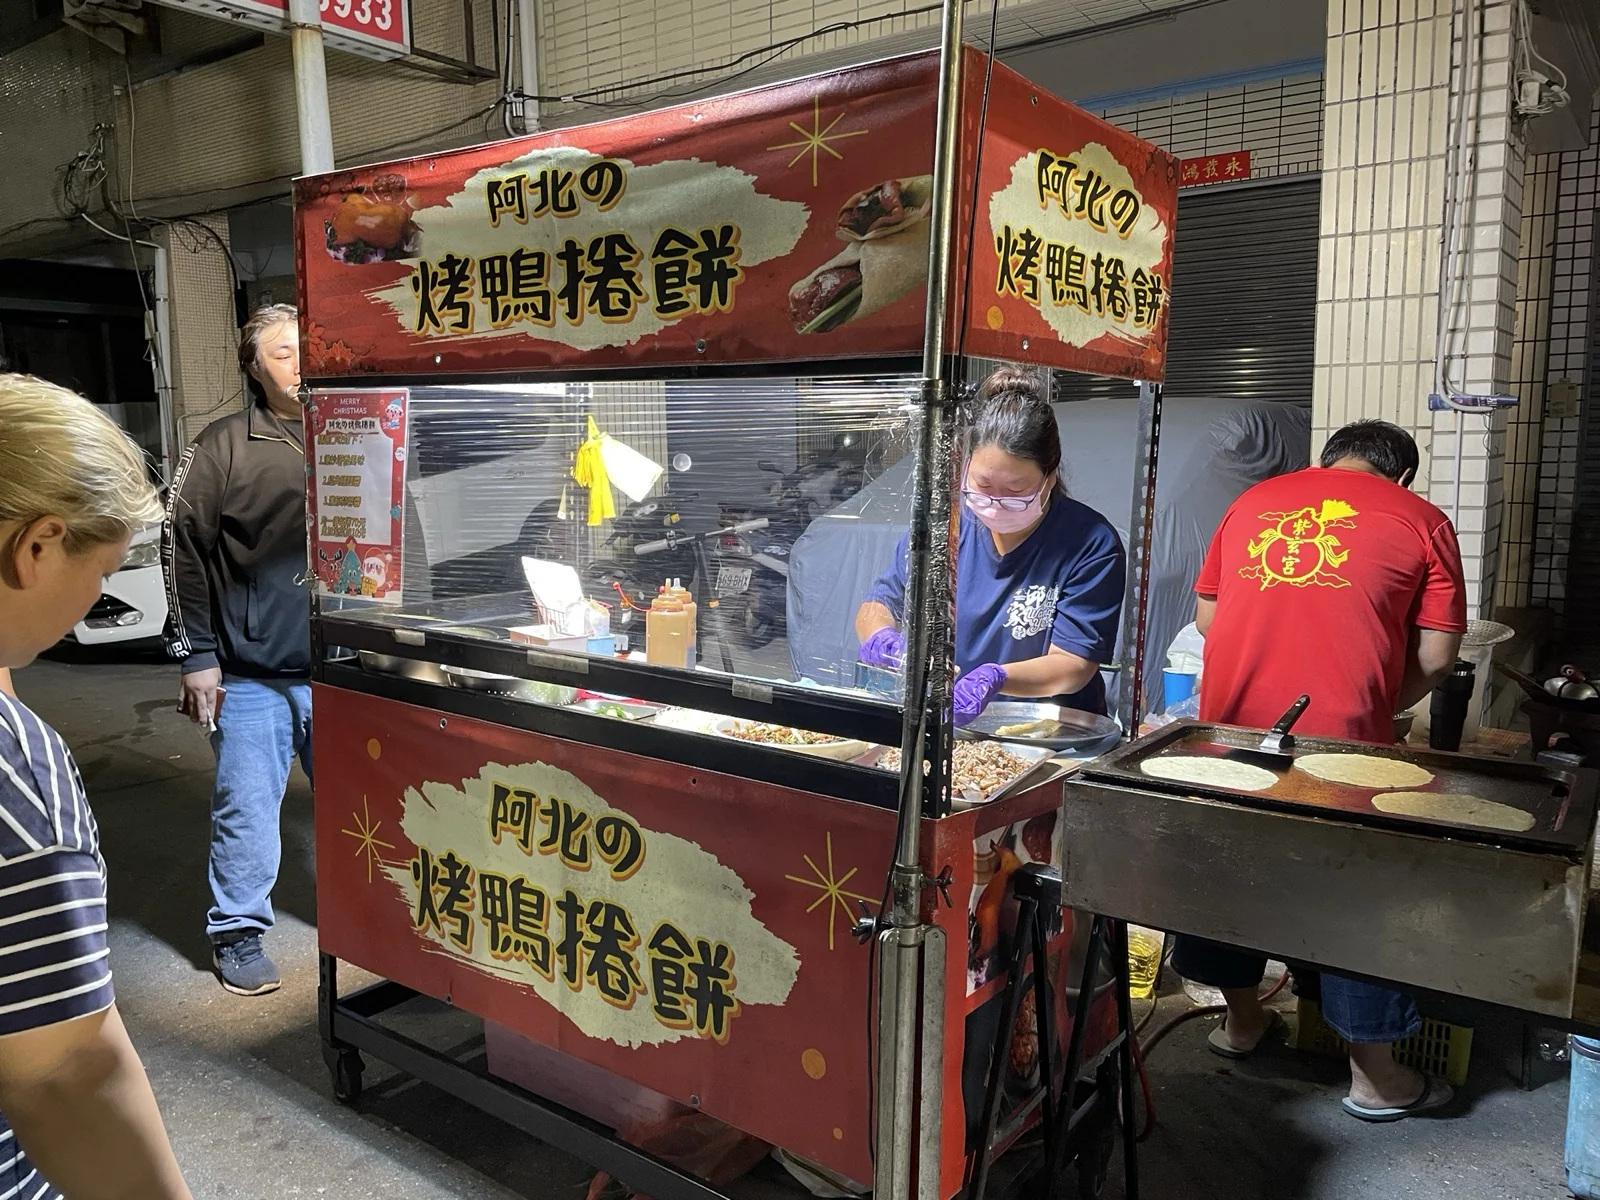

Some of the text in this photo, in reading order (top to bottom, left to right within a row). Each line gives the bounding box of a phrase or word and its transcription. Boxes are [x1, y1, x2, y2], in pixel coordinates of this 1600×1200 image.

[320, 0, 392, 31] 933
[485, 159, 627, 227] 阿北の
[1035, 149, 1141, 239] 阿北の
[410, 223, 744, 335] 烤鴨捲餅
[996, 223, 1163, 329] 烤鴨捲餅
[333, 407, 368, 415] CHRISTMAS
[489, 781, 645, 881] 阿北の
[410, 846, 741, 1045] 烤鴨捲餅
